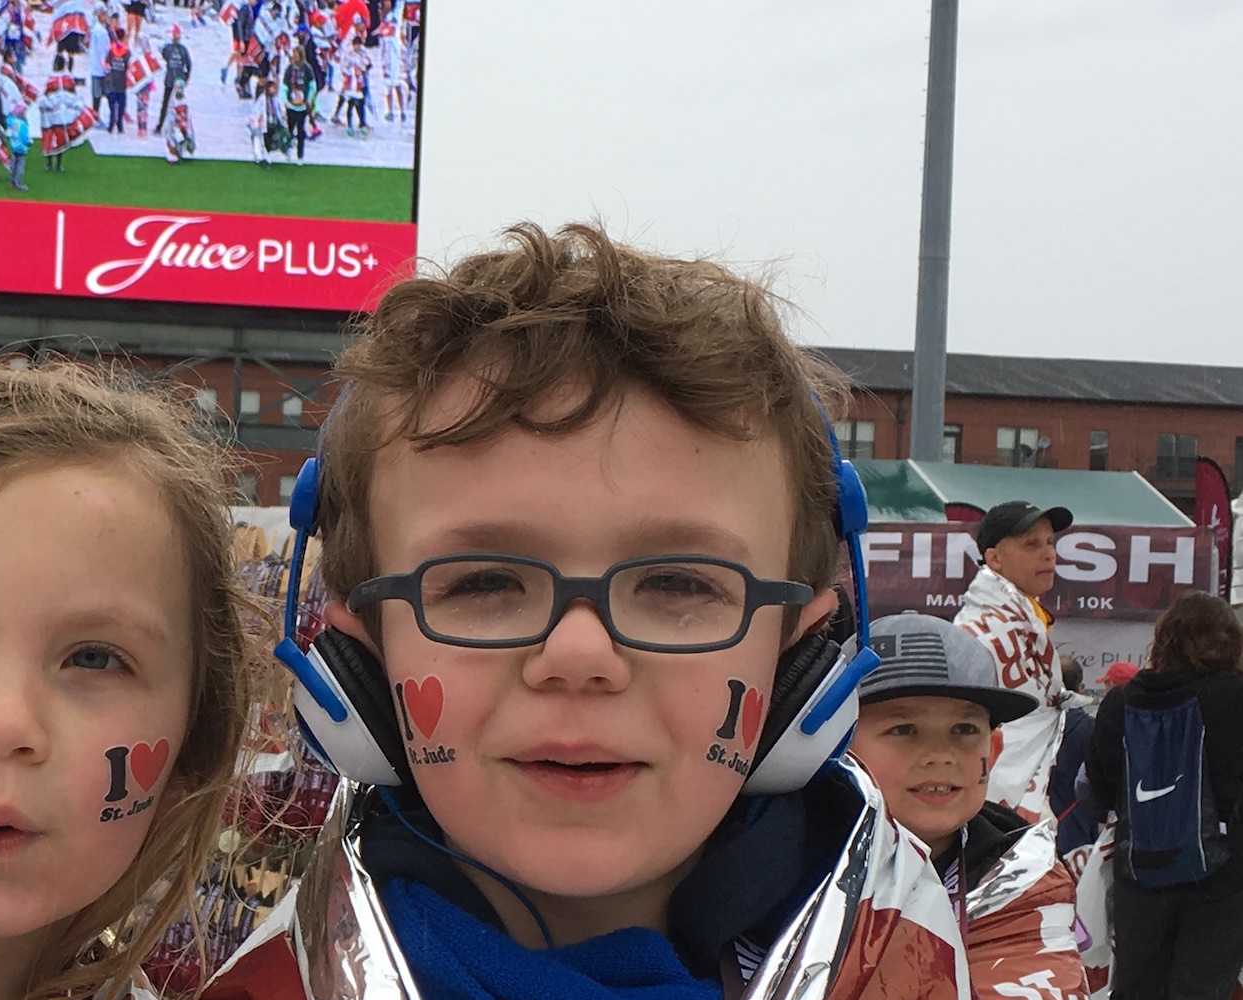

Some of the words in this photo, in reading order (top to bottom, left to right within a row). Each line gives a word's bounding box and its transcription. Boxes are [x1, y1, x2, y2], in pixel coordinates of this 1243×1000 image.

[85, 215, 255, 295] Juice
[861, 530, 1196, 585] FINSH
[1076, 596, 1114, 611] 10K
[716, 678, 747, 740] I
[104, 745, 130, 803] I
[422, 743, 457, 766] Jude
[706, 742, 728, 769] St.
